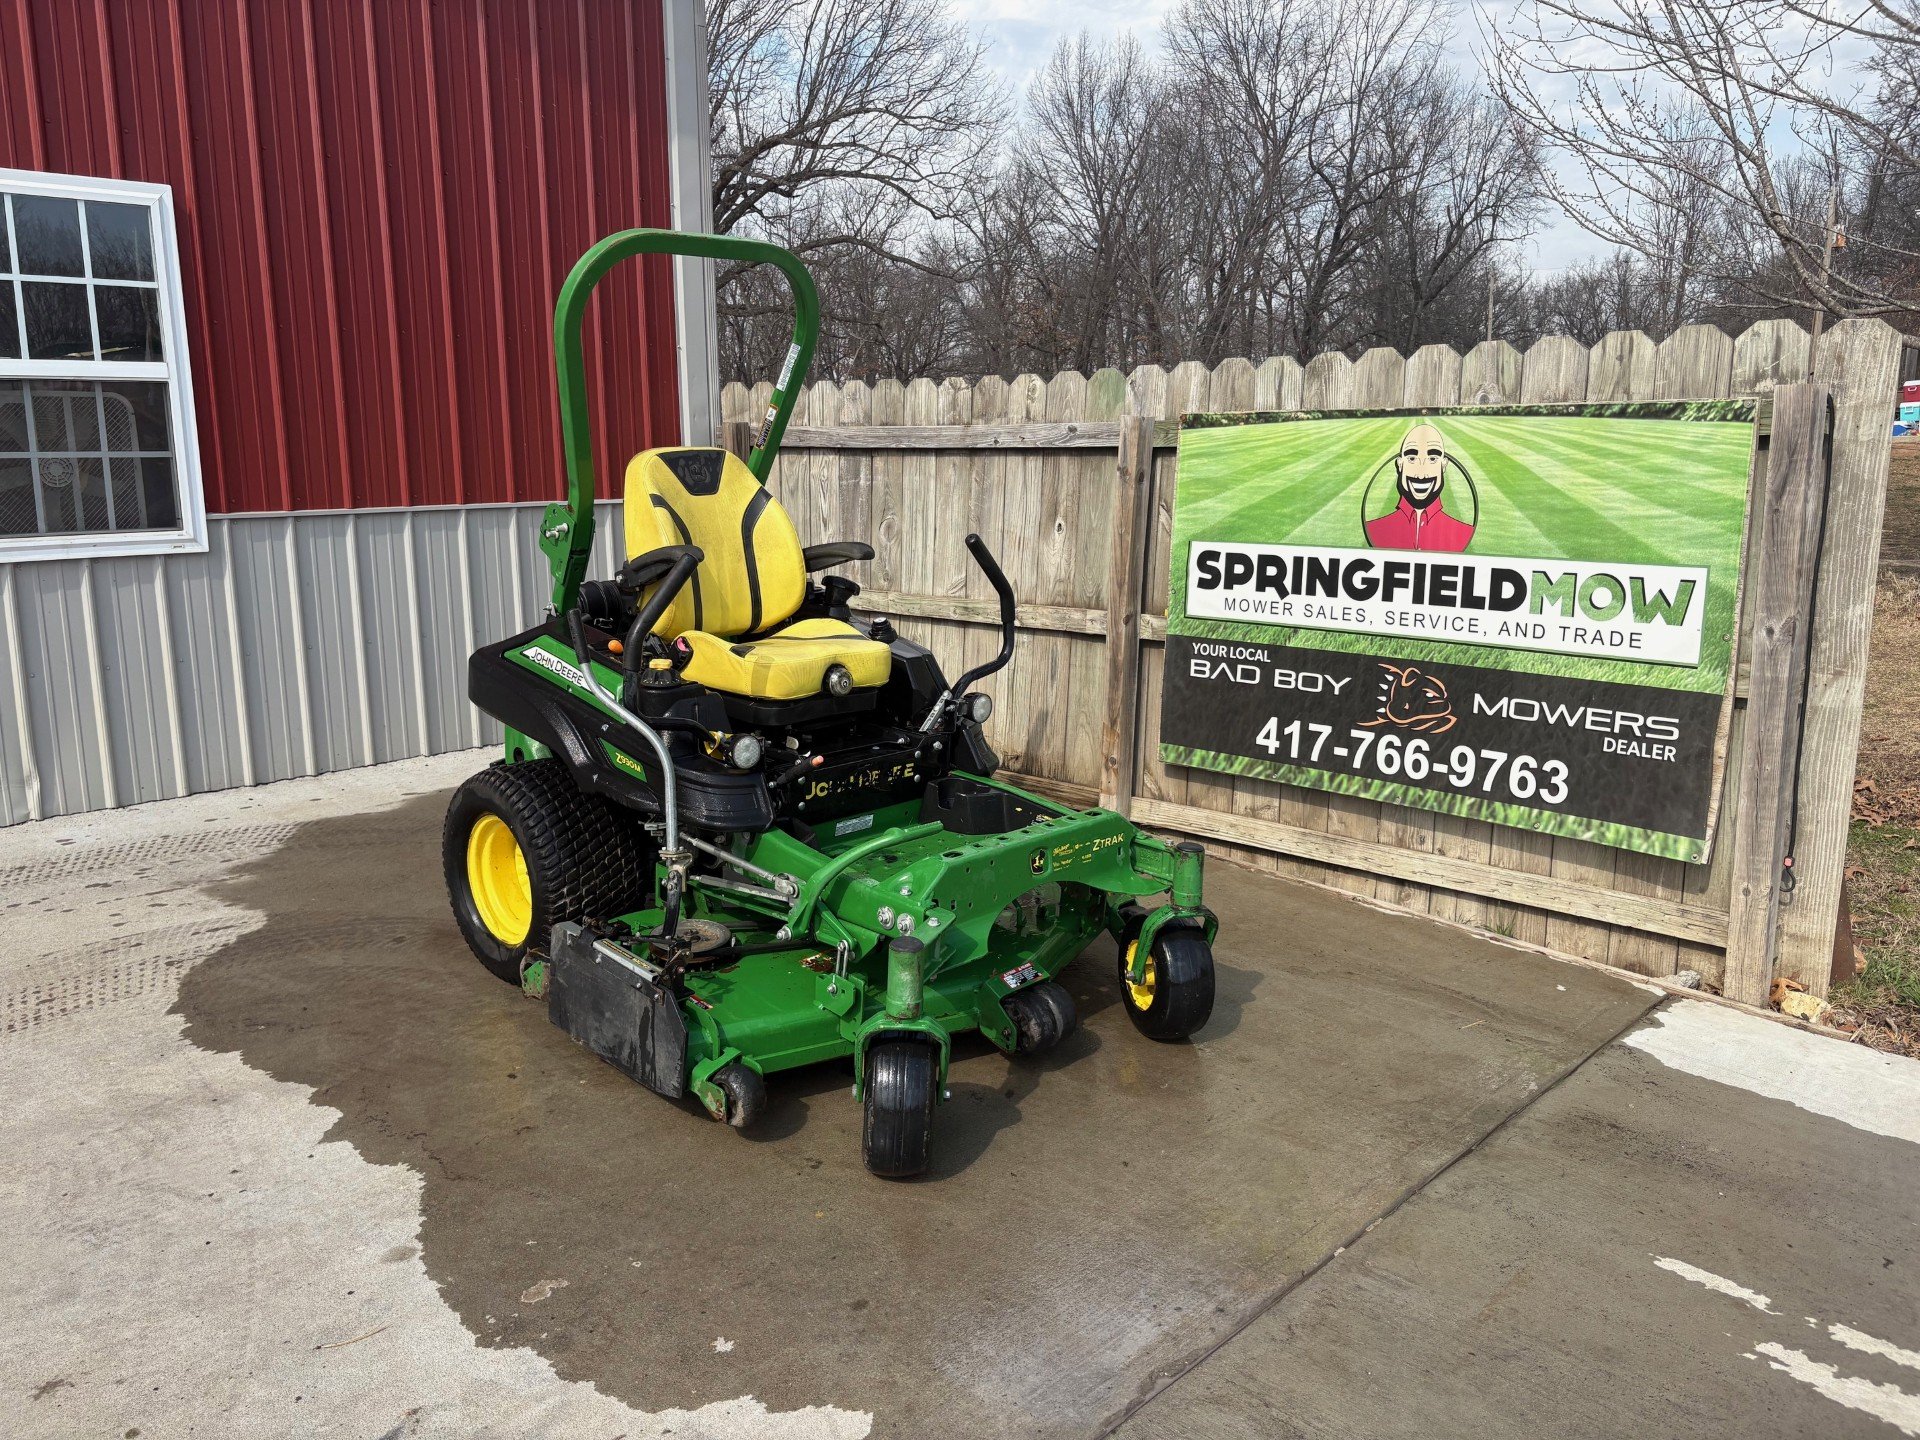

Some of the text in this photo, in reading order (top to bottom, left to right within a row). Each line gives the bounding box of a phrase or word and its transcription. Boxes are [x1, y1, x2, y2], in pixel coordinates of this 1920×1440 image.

[1196, 550, 1697, 626] SPRINGFIELDMOW
[1224, 597, 1642, 649] MOWER SALES, SERVICE, AND TRADE
[531, 649, 583, 685] JOHN DEERE
[1192, 643, 1271, 663] YOUR LOCAL
[1190, 659, 1679, 741] BAD BOY MOWERS
[1255, 716, 1569, 804] 417-766-9763
[1603, 736, 1677, 762] DEALER
